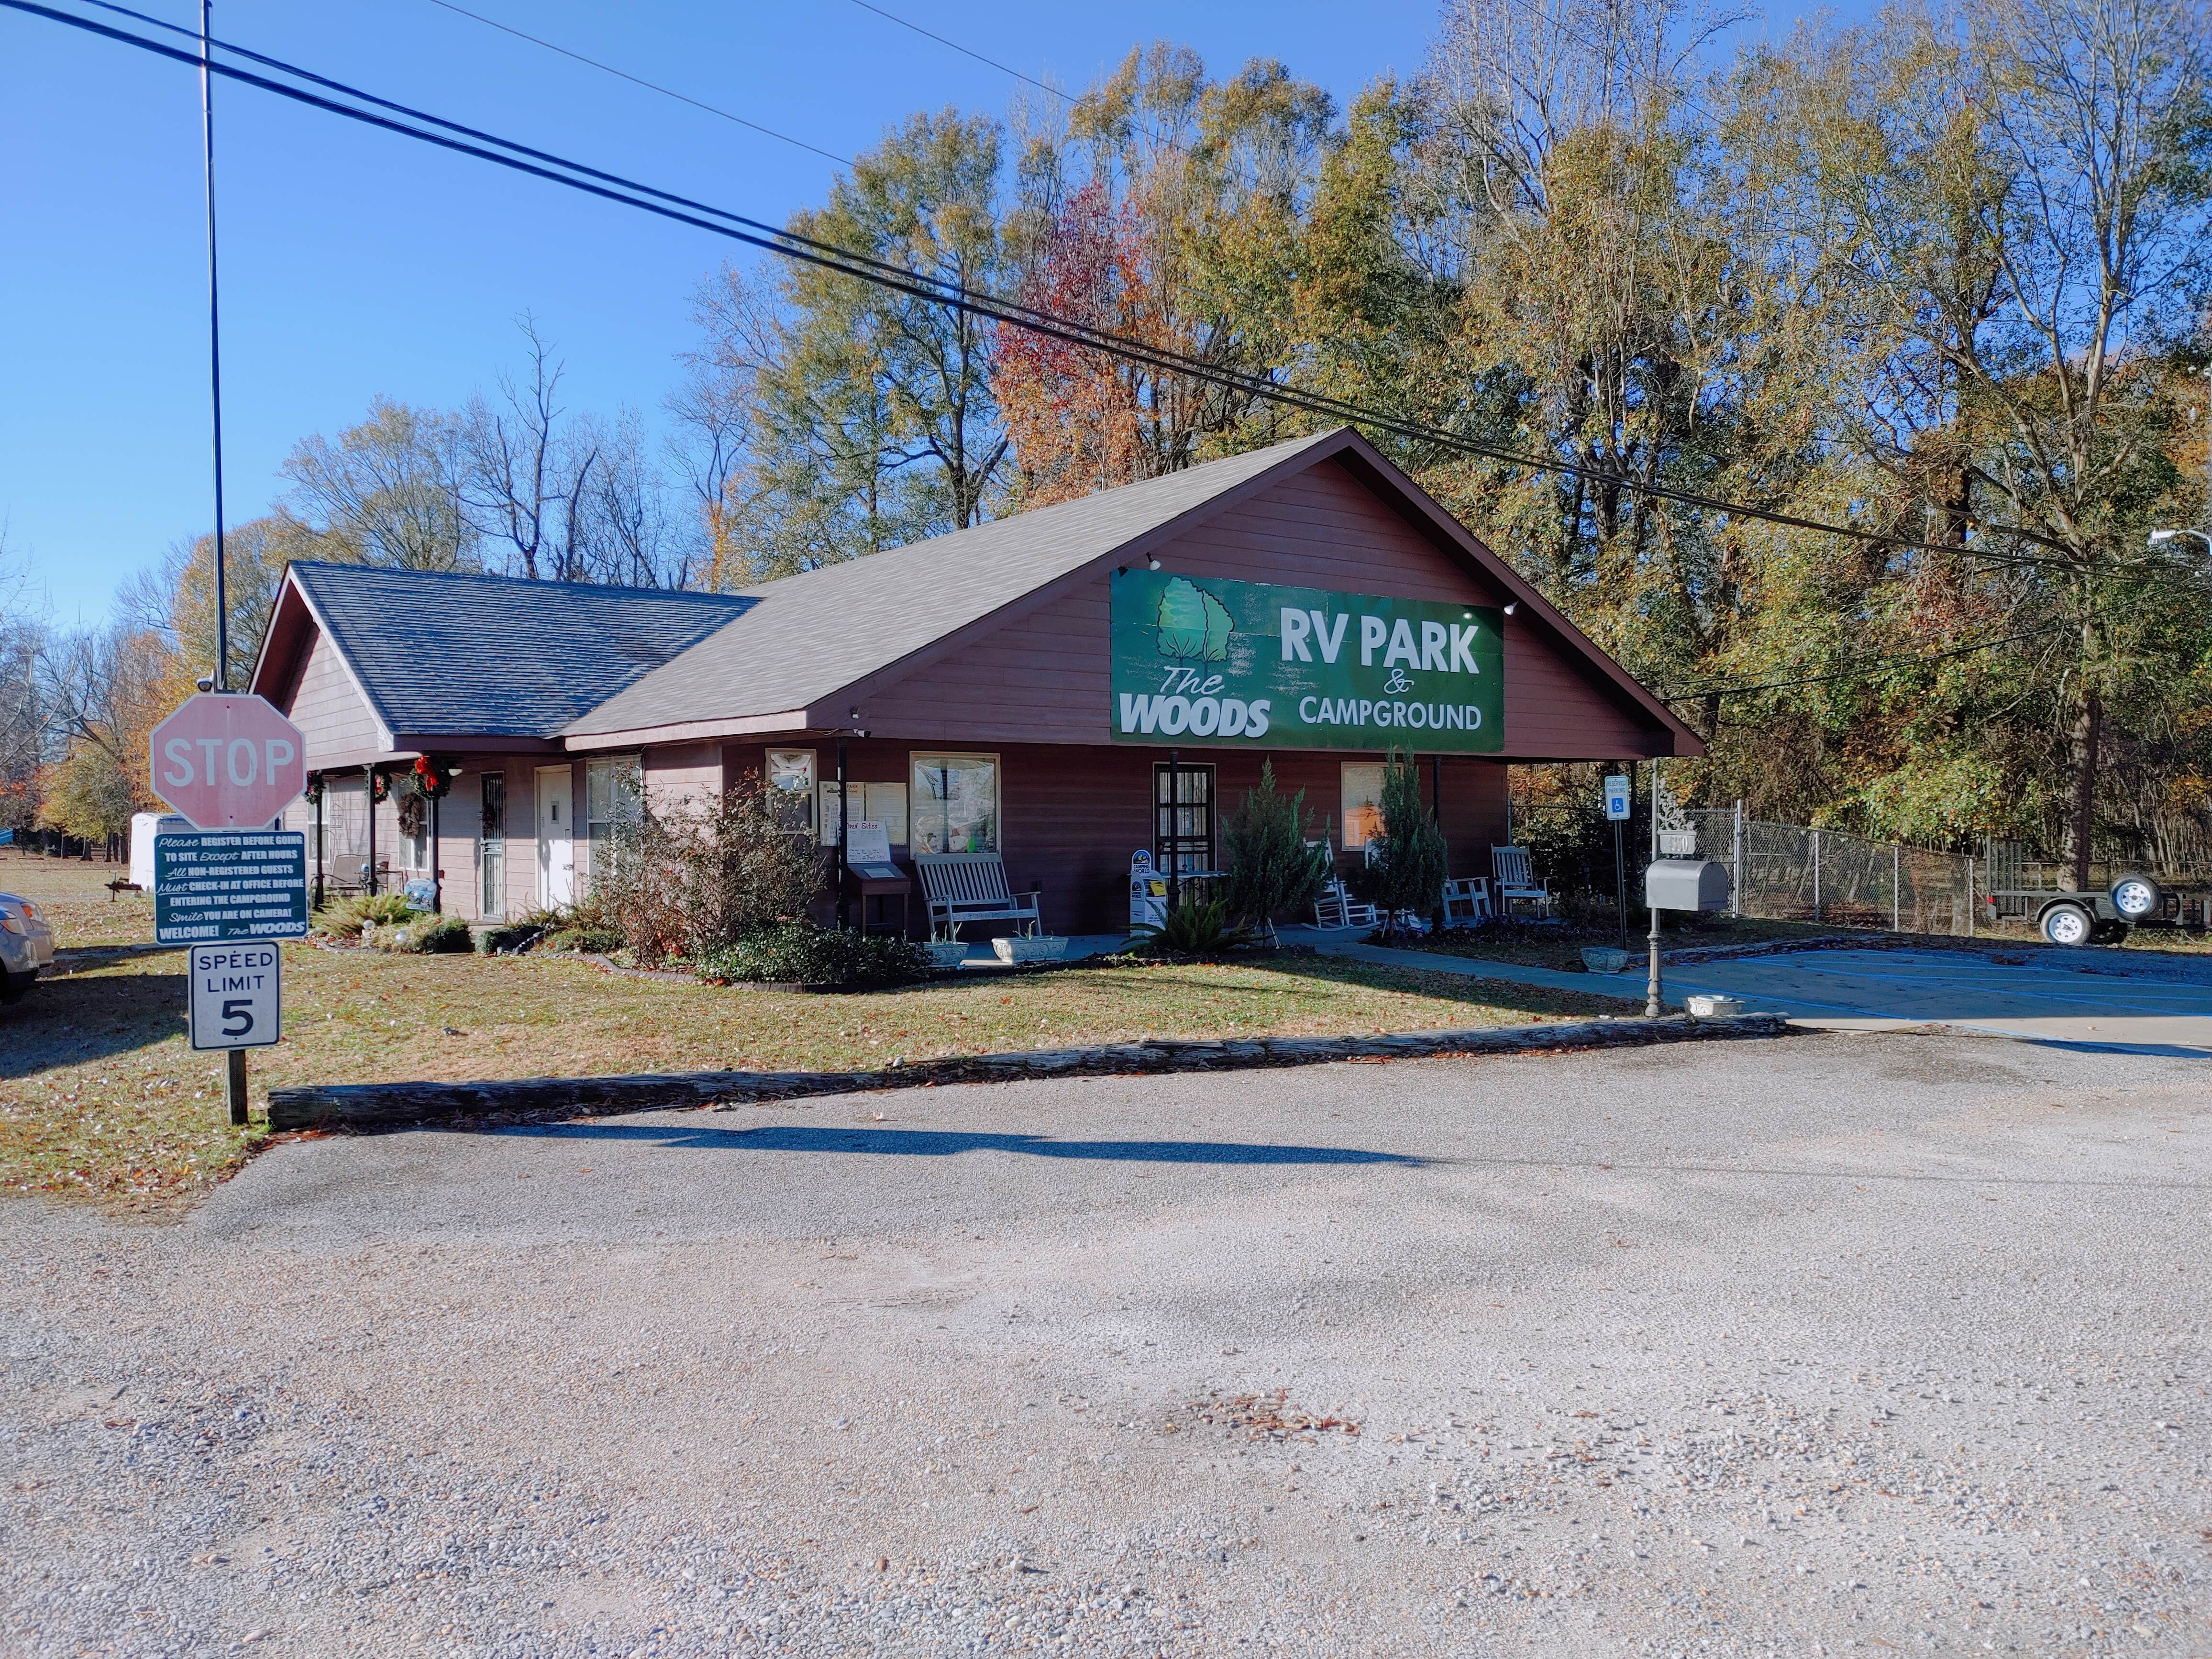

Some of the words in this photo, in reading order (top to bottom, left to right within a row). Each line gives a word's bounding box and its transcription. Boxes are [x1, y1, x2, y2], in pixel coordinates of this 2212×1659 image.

[1281, 607, 1349, 664] RV
[1360, 615, 1480, 674] PARK
[1160, 665, 1225, 695] The
[1384, 668, 1414, 694] &
[1119, 693, 1271, 738] WOODS
[1299, 696, 1482, 730] CAMPGROUND
[164, 738, 294, 787] STOP
[159, 838, 199, 847] Please
[201, 837, 241, 846] REGISTER
[243, 836, 275, 845] BEFORE
[276, 836, 303, 844] GOING
[166, 853, 177, 862] TO
[178, 852, 197, 862] SITE
[199, 852, 240, 863] Except
[241, 851, 267, 860] AFTER
[268, 850, 298, 859] HOURS
[165, 868, 187, 877] All
[188, 866, 259, 876] NON-REGISTERED
[261, 865, 293, 874] GUESTS
[156, 883, 189, 893] Must
[189, 881, 229, 891] CHECK-IN
[231, 881, 241, 889] AT
[243, 880, 271, 889] OFFICE
[273, 879, 304, 888] BEFORE
[170, 896, 211, 907] ENTERING
[213, 896, 228, 904] THE
[230, 893, 290, 904] CAMPGROUND
[169, 912, 203, 923] Smile
[203, 911, 221, 920] YOU
[222, 910, 238, 919] ARE
[240, 910, 252, 918] ON
[254, 908, 292, 918] CAMERA!
[159, 925, 220, 940] WELCOME!
[249, 922, 306, 934] WOODS
[199, 952, 273, 970] SPEED
[208, 975, 265, 992] LIMIT
[221, 999, 254, 1036] 5
